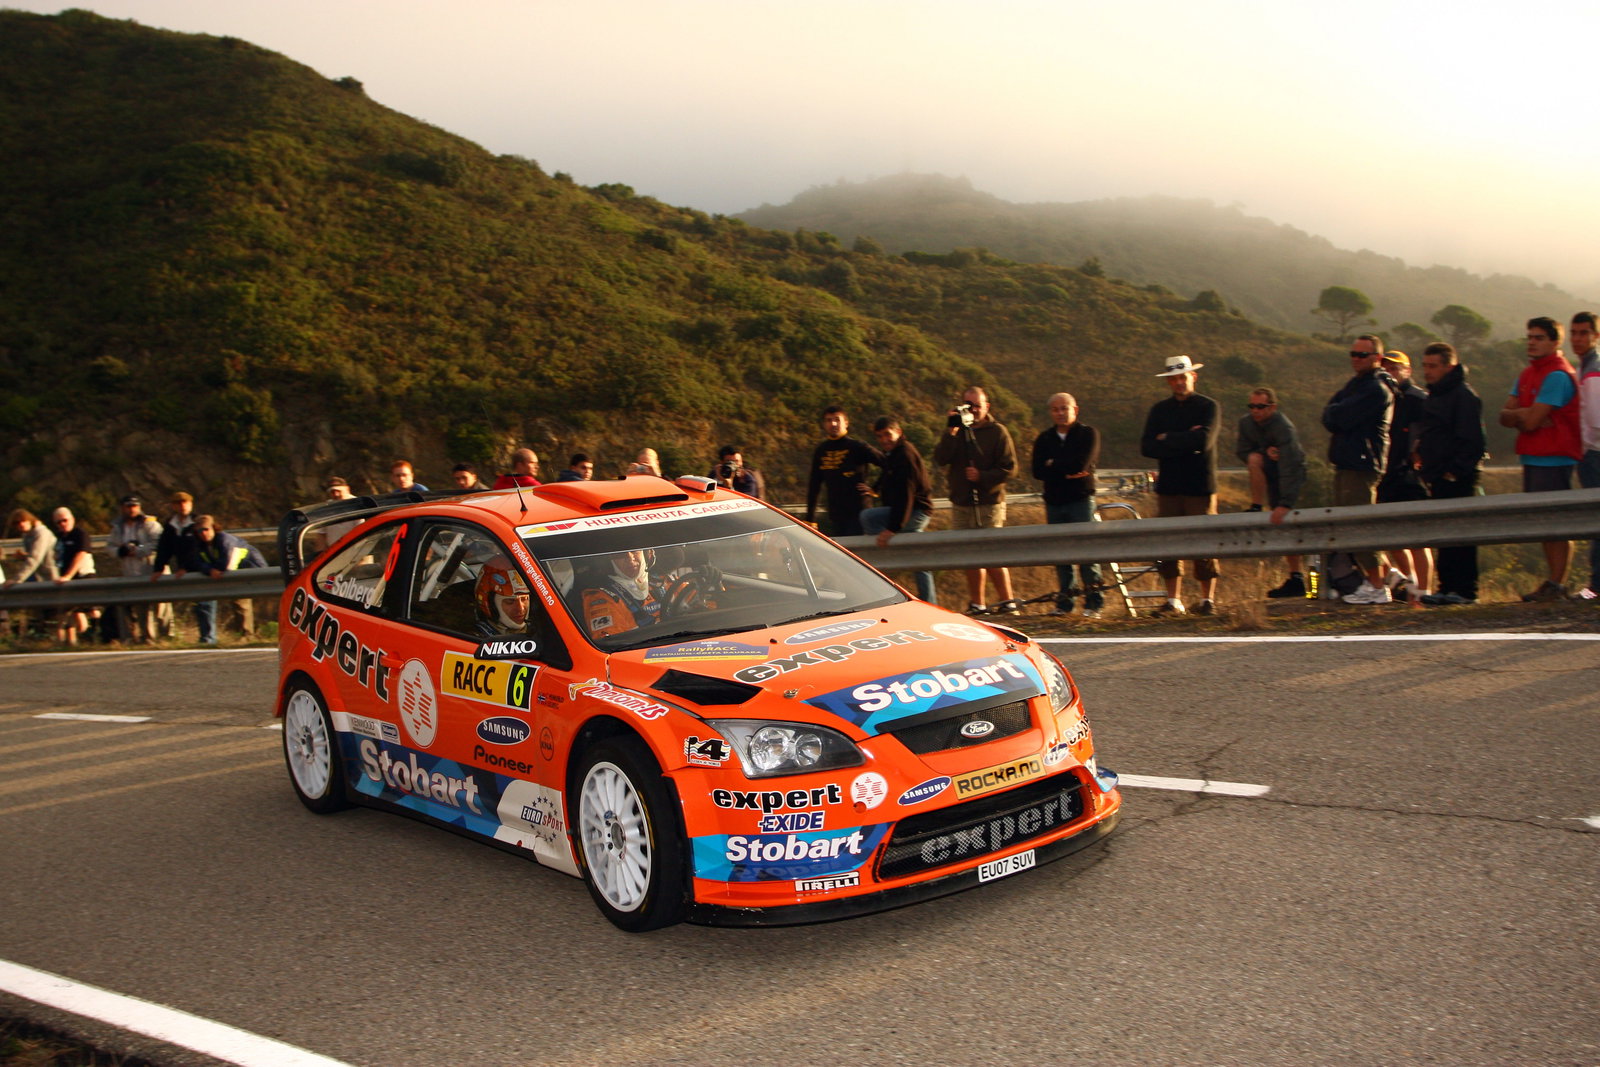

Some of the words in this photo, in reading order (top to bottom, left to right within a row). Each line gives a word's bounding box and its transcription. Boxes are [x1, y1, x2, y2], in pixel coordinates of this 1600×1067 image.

[584, 509, 689, 528] HURTIGRUTA
[691, 500, 759, 515] CARGLASS
[511, 541, 555, 606] spydebergreklame.no
[331, 573, 376, 609] Solberg
[288, 586, 392, 704] expert
[795, 621, 873, 639] SAMSUNG
[480, 640, 537, 657] NIKKO
[733, 629, 938, 684] expert
[453, 660, 497, 696] RACC
[513, 666, 528, 707] 6
[852, 658, 1025, 712] Stobart
[483, 719, 525, 741] SAMSUNG
[969, 722, 990, 734] Ford
[474, 744, 534, 775] Pioneer
[359, 738, 483, 816] Stobart
[903, 781, 947, 800] SAMSUNG
[711, 783, 843, 815] expert
[758, 811, 825, 833] EXIDE
[920, 791, 1074, 864] expert
[726, 831, 864, 863] Stobart
[981, 859, 1010, 880] EU07
[1012, 850, 1035, 868] SUV
[795, 871, 860, 892] PIRELLI
